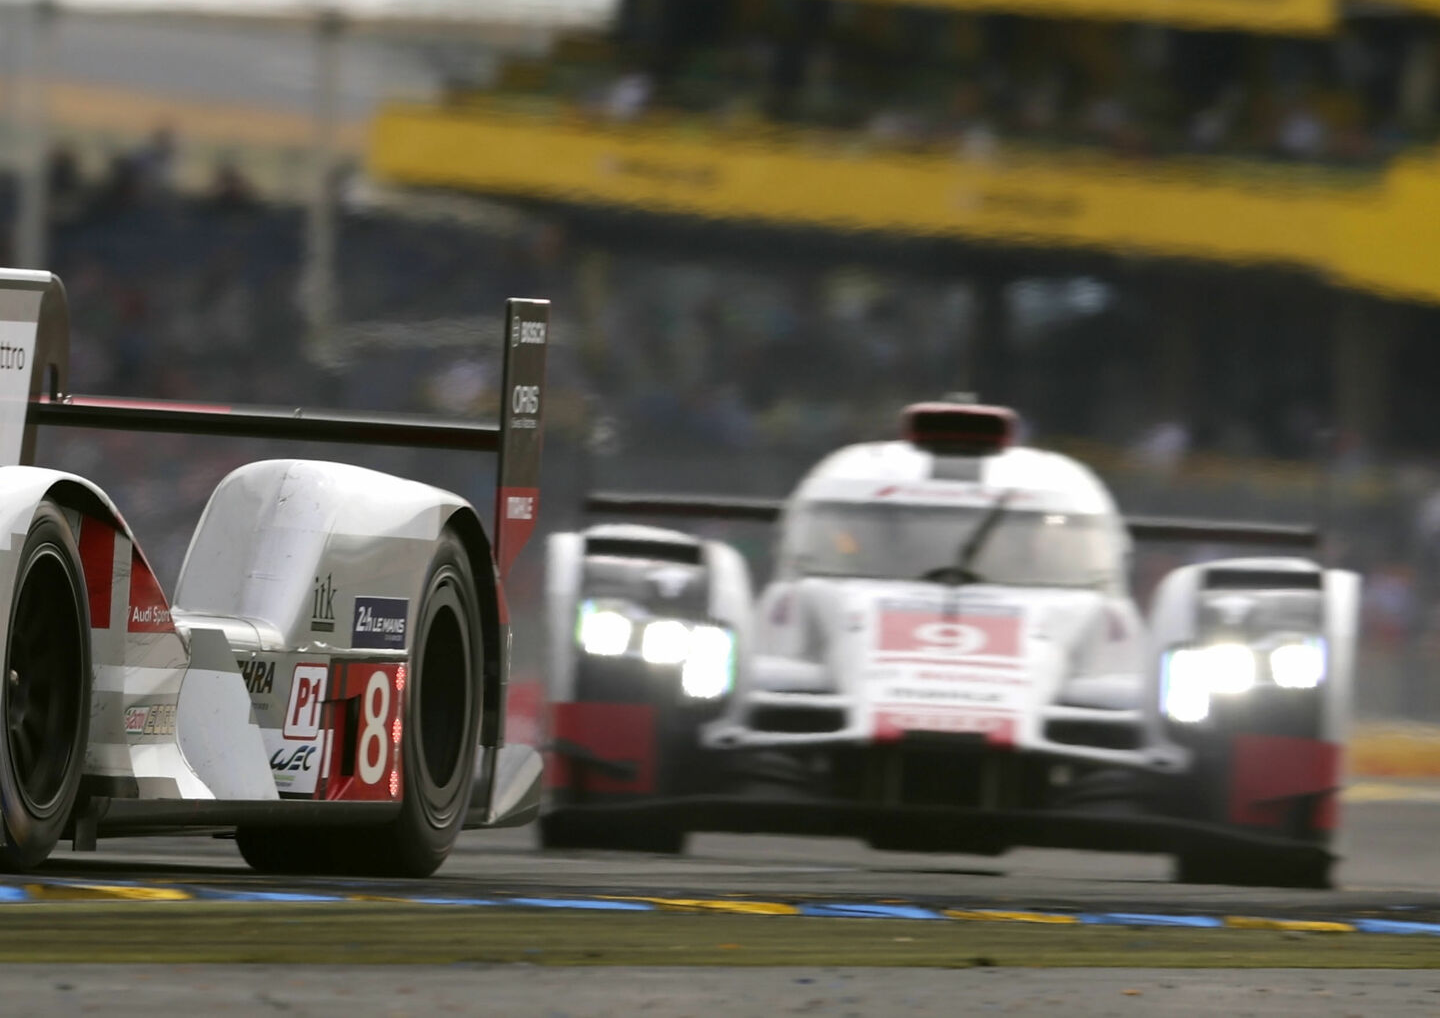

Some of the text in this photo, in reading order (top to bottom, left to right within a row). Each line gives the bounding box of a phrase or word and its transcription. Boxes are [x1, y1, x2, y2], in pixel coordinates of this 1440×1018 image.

[512, 385, 539, 414] ORIS
[132, 605, 170, 626] Audi Sport
[372, 617, 384, 632] LE
[384, 617, 405, 633] MANS
[914, 622, 987, 655] 9
[291, 677, 321, 727] P1
[358, 670, 390, 785] 8
[270, 744, 317, 772] WEC
